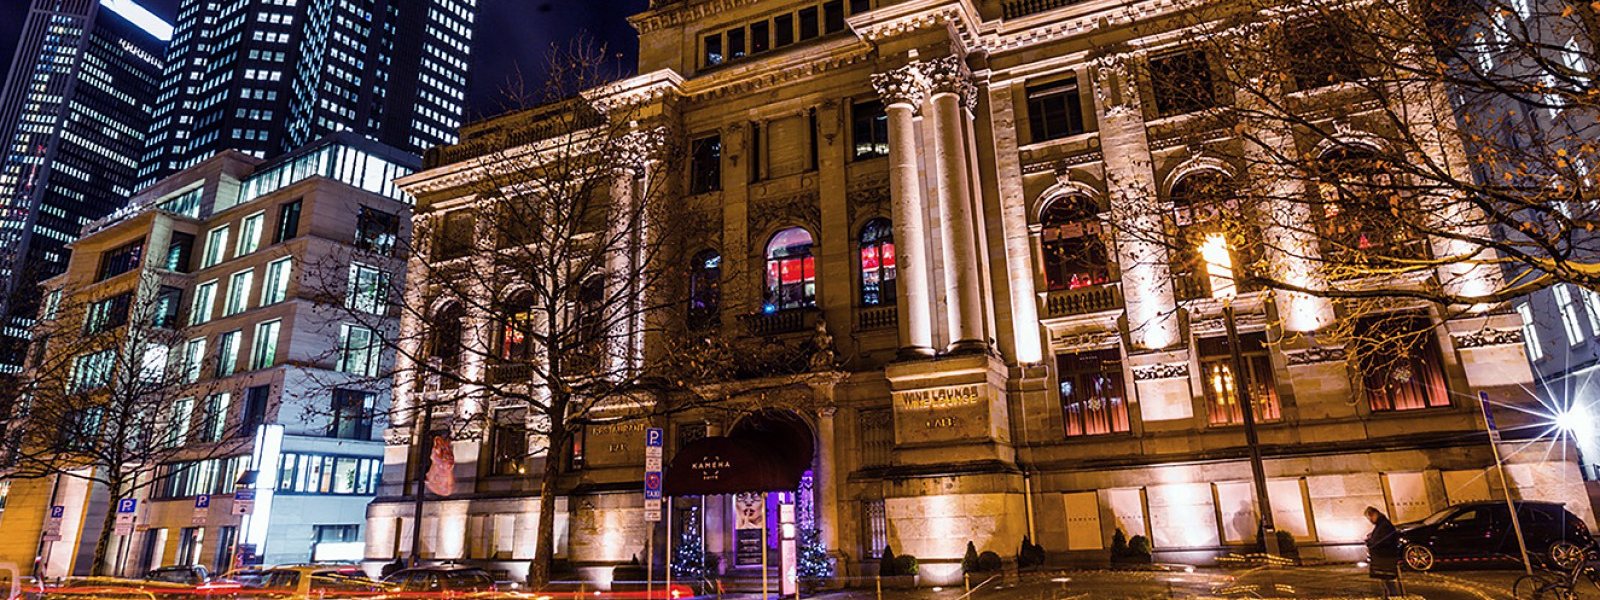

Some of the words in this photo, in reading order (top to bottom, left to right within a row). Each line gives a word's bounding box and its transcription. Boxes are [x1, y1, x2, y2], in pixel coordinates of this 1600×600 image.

[931, 386, 978, 408] LOUNGE
[650, 430, 659, 445] P
[691, 461, 731, 470] KAMEHA
[646, 489, 660, 497] TAXI
[121, 500, 133, 511] P
[198, 495, 208, 506] P
[53, 506, 62, 517] P
